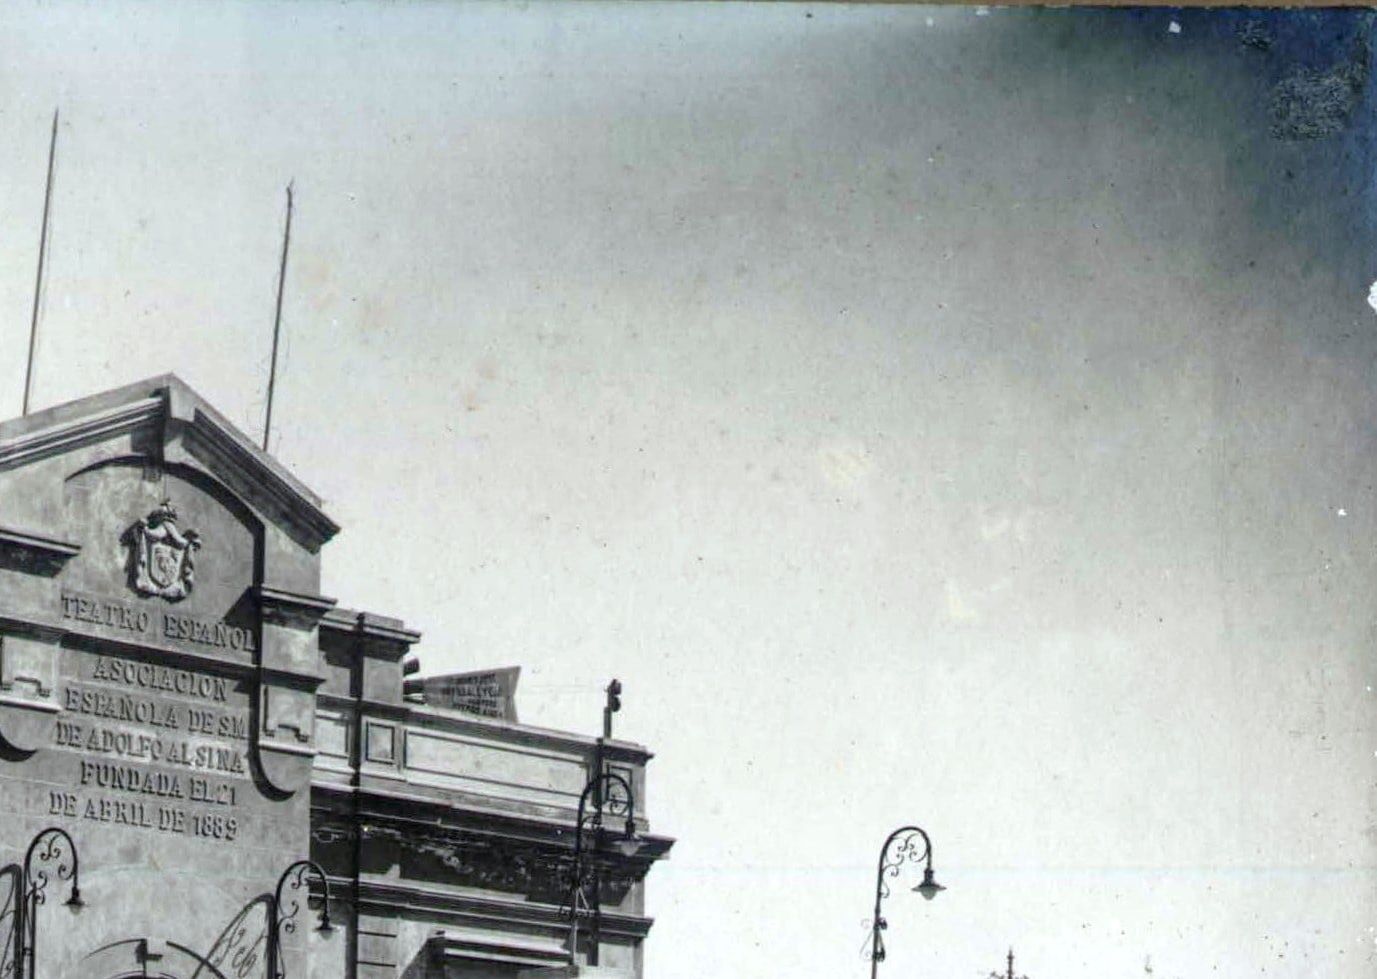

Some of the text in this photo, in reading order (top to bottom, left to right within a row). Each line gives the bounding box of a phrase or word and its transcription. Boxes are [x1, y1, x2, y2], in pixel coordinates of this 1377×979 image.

[60, 594, 256, 651] TEATRO ESPAÑOL
[93, 658, 227, 702] ASOCIACION
[65, 687, 180, 729] ESPAÑOLA
[188, 709, 214, 735] DE
[56, 721, 245, 774] DE ADOLFO ALSINA
[80, 761, 184, 799] FUNDADA
[189, 777, 215, 803] EL
[49, 791, 238, 841] DE ABRIL DE 1889
